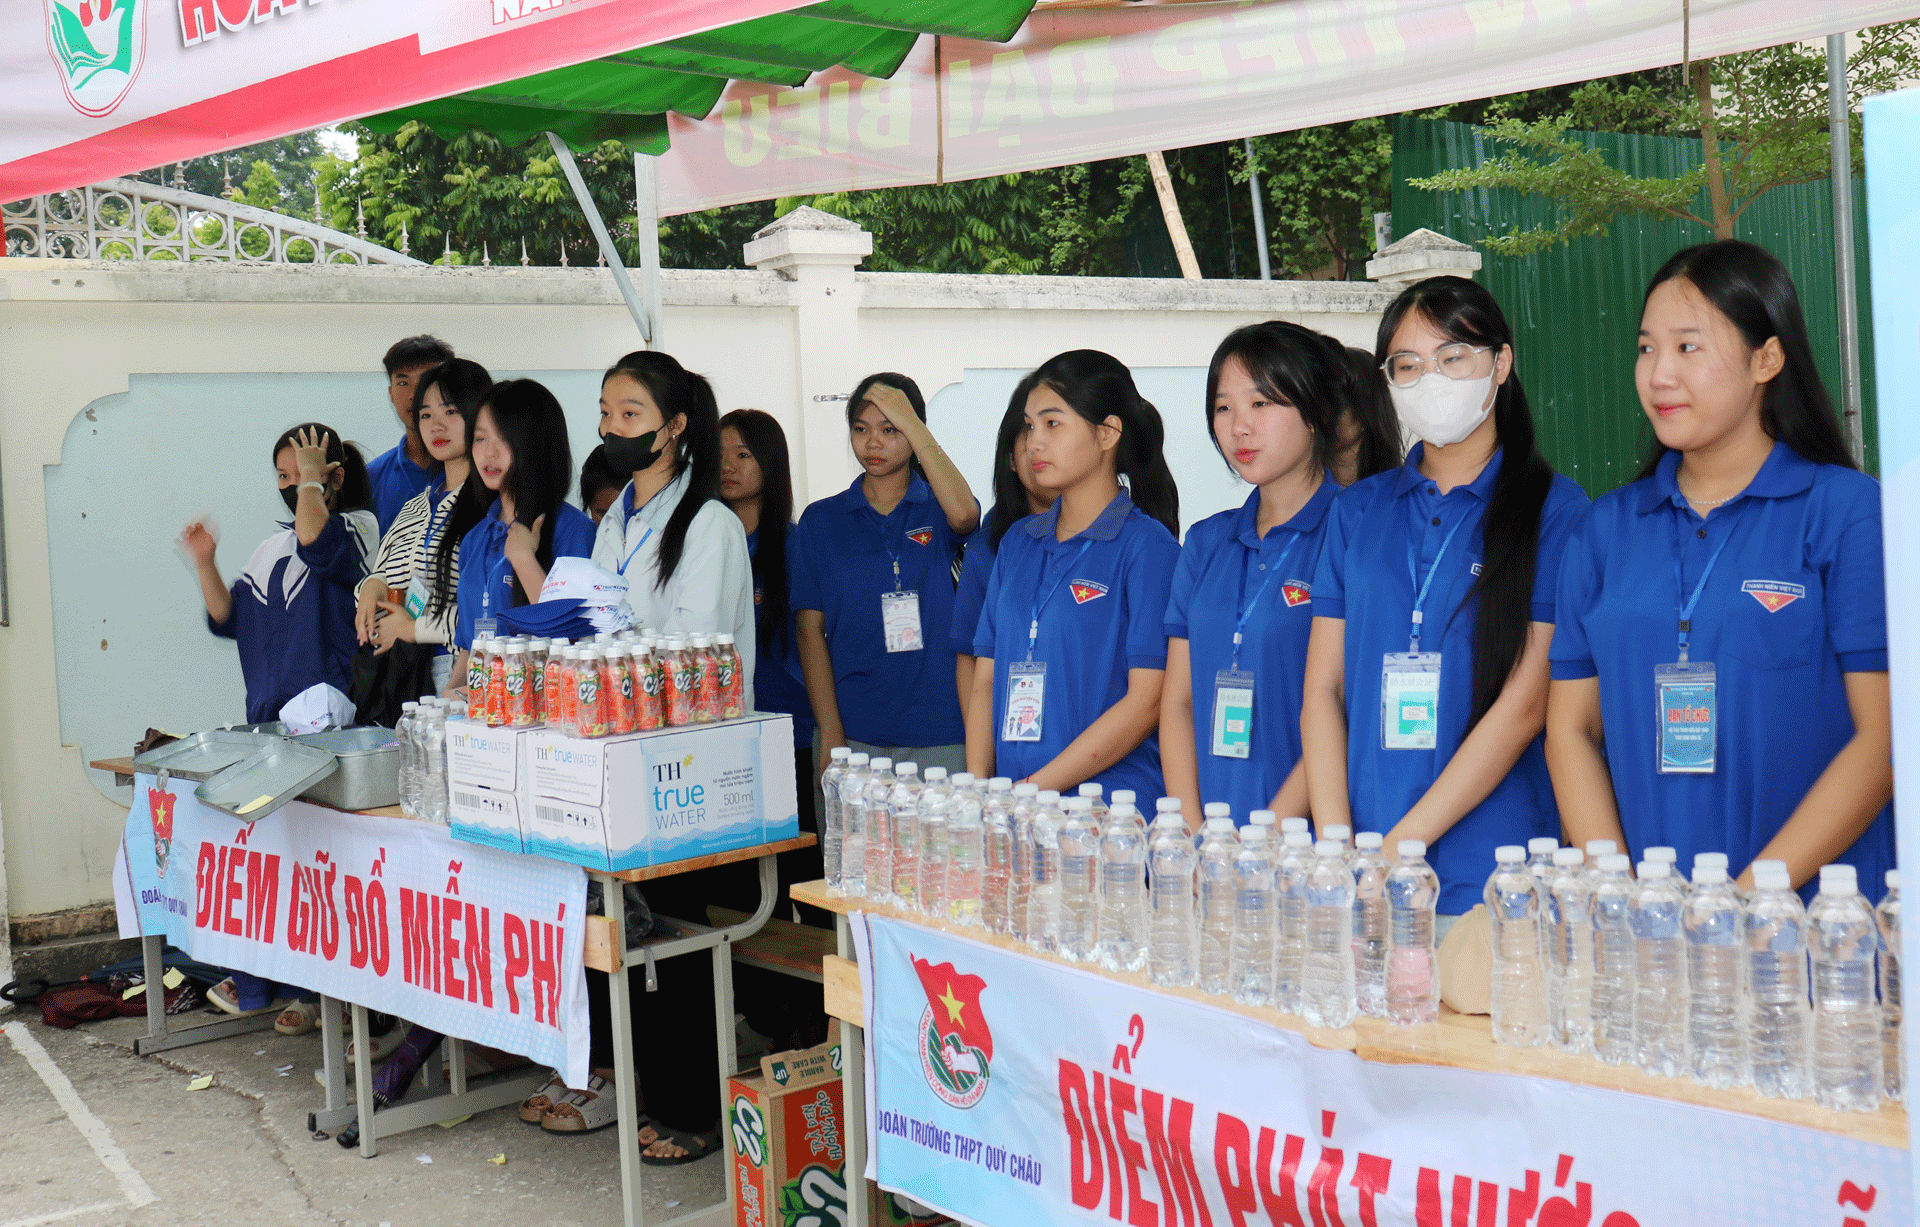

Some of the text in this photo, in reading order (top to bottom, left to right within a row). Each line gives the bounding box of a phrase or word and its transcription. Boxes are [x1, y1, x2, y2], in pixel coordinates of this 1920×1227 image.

[506, 675, 524, 694] C2
[578, 683, 597, 703] C2
[674, 672, 692, 692] C2
[554, 748, 573, 763] true
[653, 761, 682, 783] TH
[653, 784, 705, 812] true
[723, 792, 740, 806] 500
[655, 807, 706, 830] WATER
[287, 850, 339, 961] GIỮ
[344, 847, 390, 978] ĐỒ
[400, 859, 493, 1009] MIỄN
[503, 902, 566, 1032] PHÍ
[775, 1068, 788, 1081] UP
[1058, 1014, 1214, 1227] ĐIỂM
[732, 1097, 763, 1168] C2
[910, 1118, 951, 1155] TRƯỜNG
[954, 1133, 983, 1165] THPT
[985, 1145, 1007, 1173] QUỲ
[1010, 1153, 1042, 1186] CHÂU
